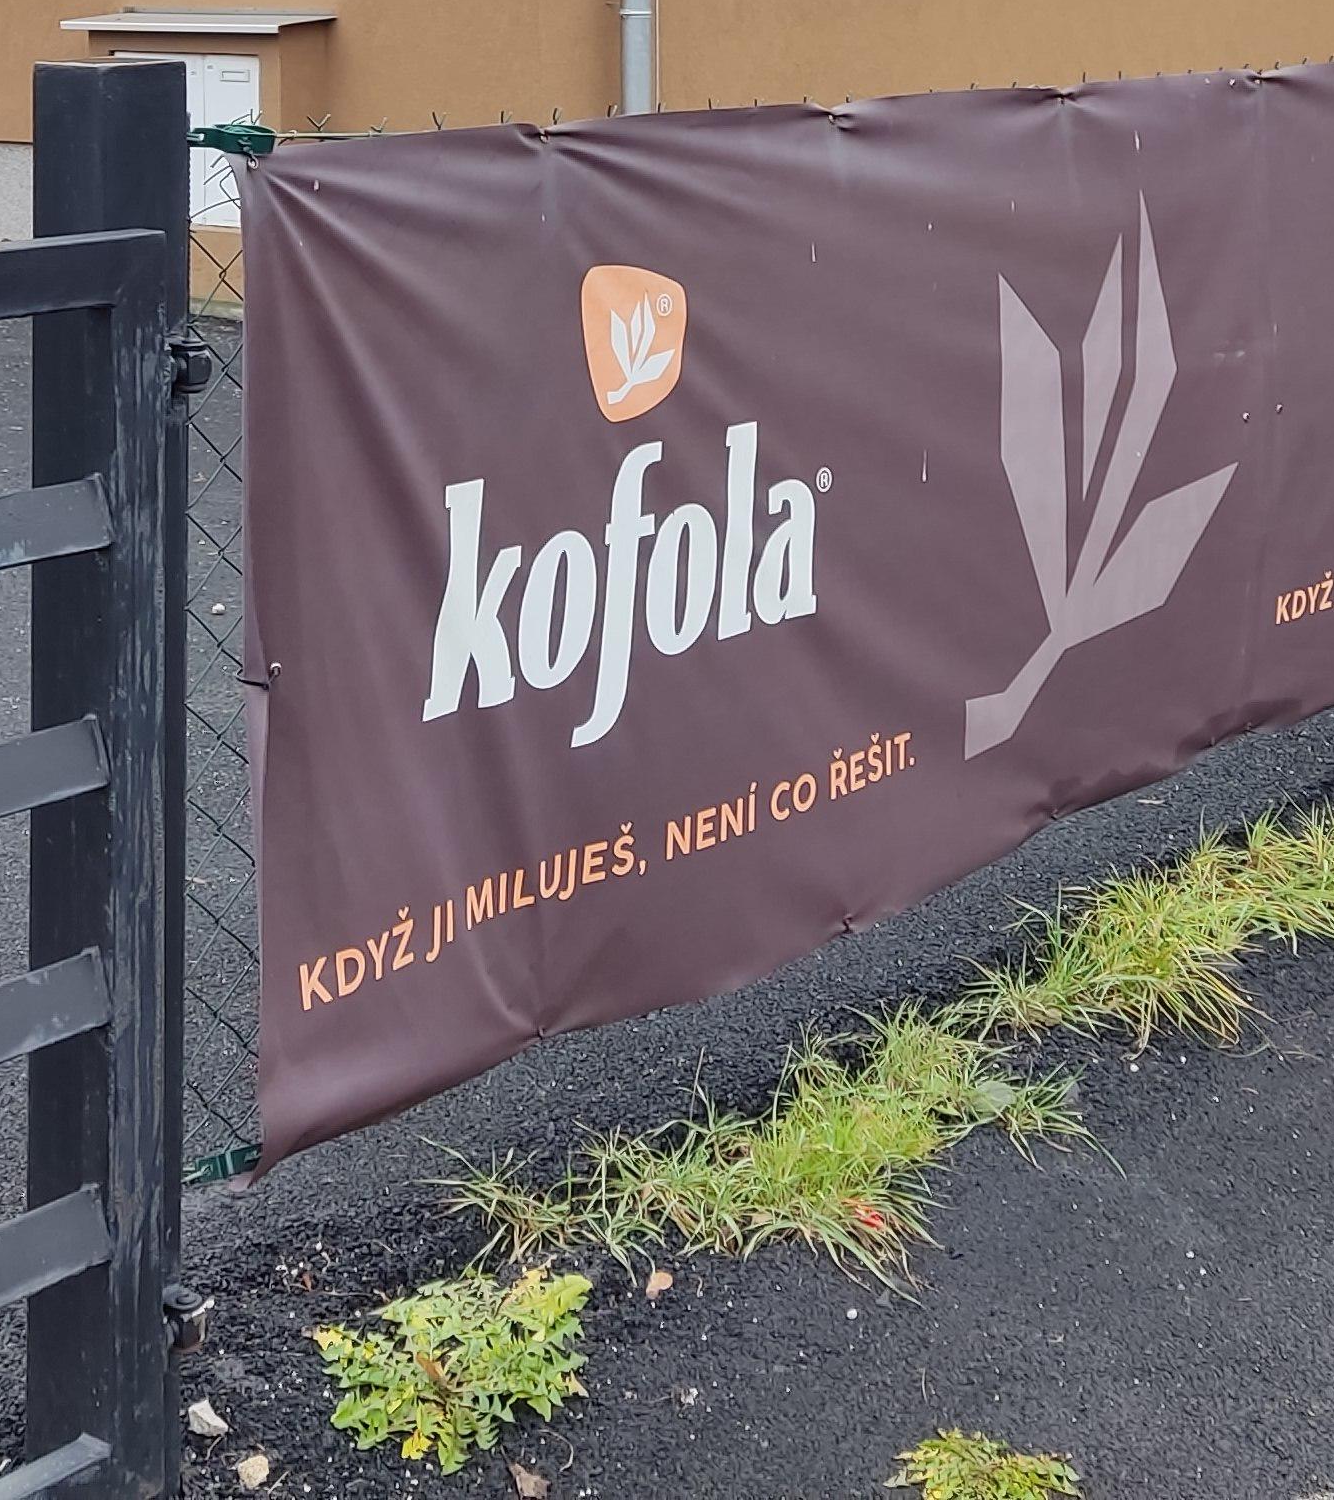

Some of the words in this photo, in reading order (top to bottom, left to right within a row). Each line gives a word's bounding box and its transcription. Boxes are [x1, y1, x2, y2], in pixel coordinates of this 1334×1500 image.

[422, 421, 818, 747] kofola
[1275, 570, 1334, 625] KDYŽ
[299, 909, 415, 1011] KDYŽ
[426, 900, 454, 962] JI
[467, 821, 647, 931] MILUJEŠ,
[665, 782, 757, 861] NENÍ
[770, 772, 817, 822] CO
[830, 732, 916, 800] ŘEŠIT.
